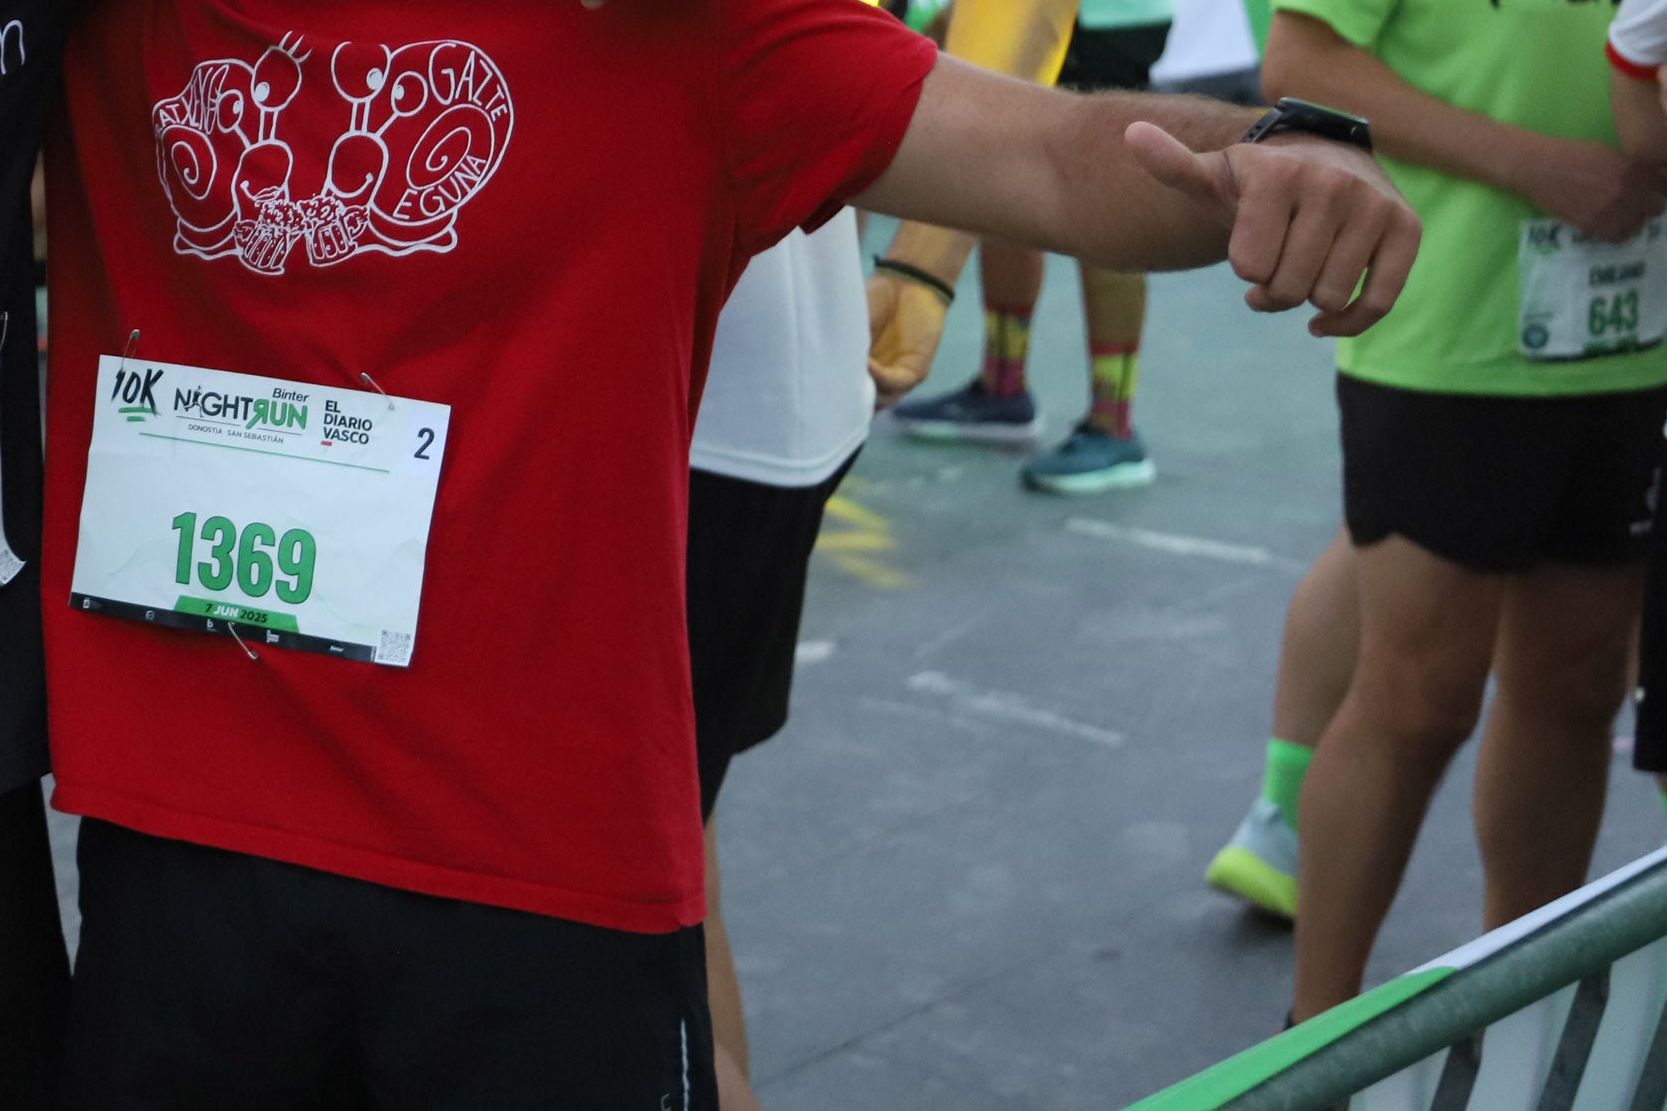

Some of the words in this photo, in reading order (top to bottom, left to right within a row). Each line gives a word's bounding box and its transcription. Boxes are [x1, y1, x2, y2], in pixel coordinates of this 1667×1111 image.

[428, 43, 508, 121] GAZTE
[393, 154, 487, 219] EGUNA
[1588, 289, 1639, 336] 643
[111, 368, 163, 416] 10K
[272, 388, 309, 403] Binter
[325, 400, 341, 413] EL
[188, 423, 223, 435] DONOSTIA
[227, 429, 242, 438] SAN
[244, 431, 284, 444] SEBASTIÁN
[323, 413, 373, 432] DIARIO
[323, 427, 370, 445] VASCO
[414, 427, 435, 460] 2
[172, 511, 317, 604] 1369
[205, 603, 213, 613] 7
[213, 605, 239, 618] JUN
[240, 609, 268, 624] 2025
